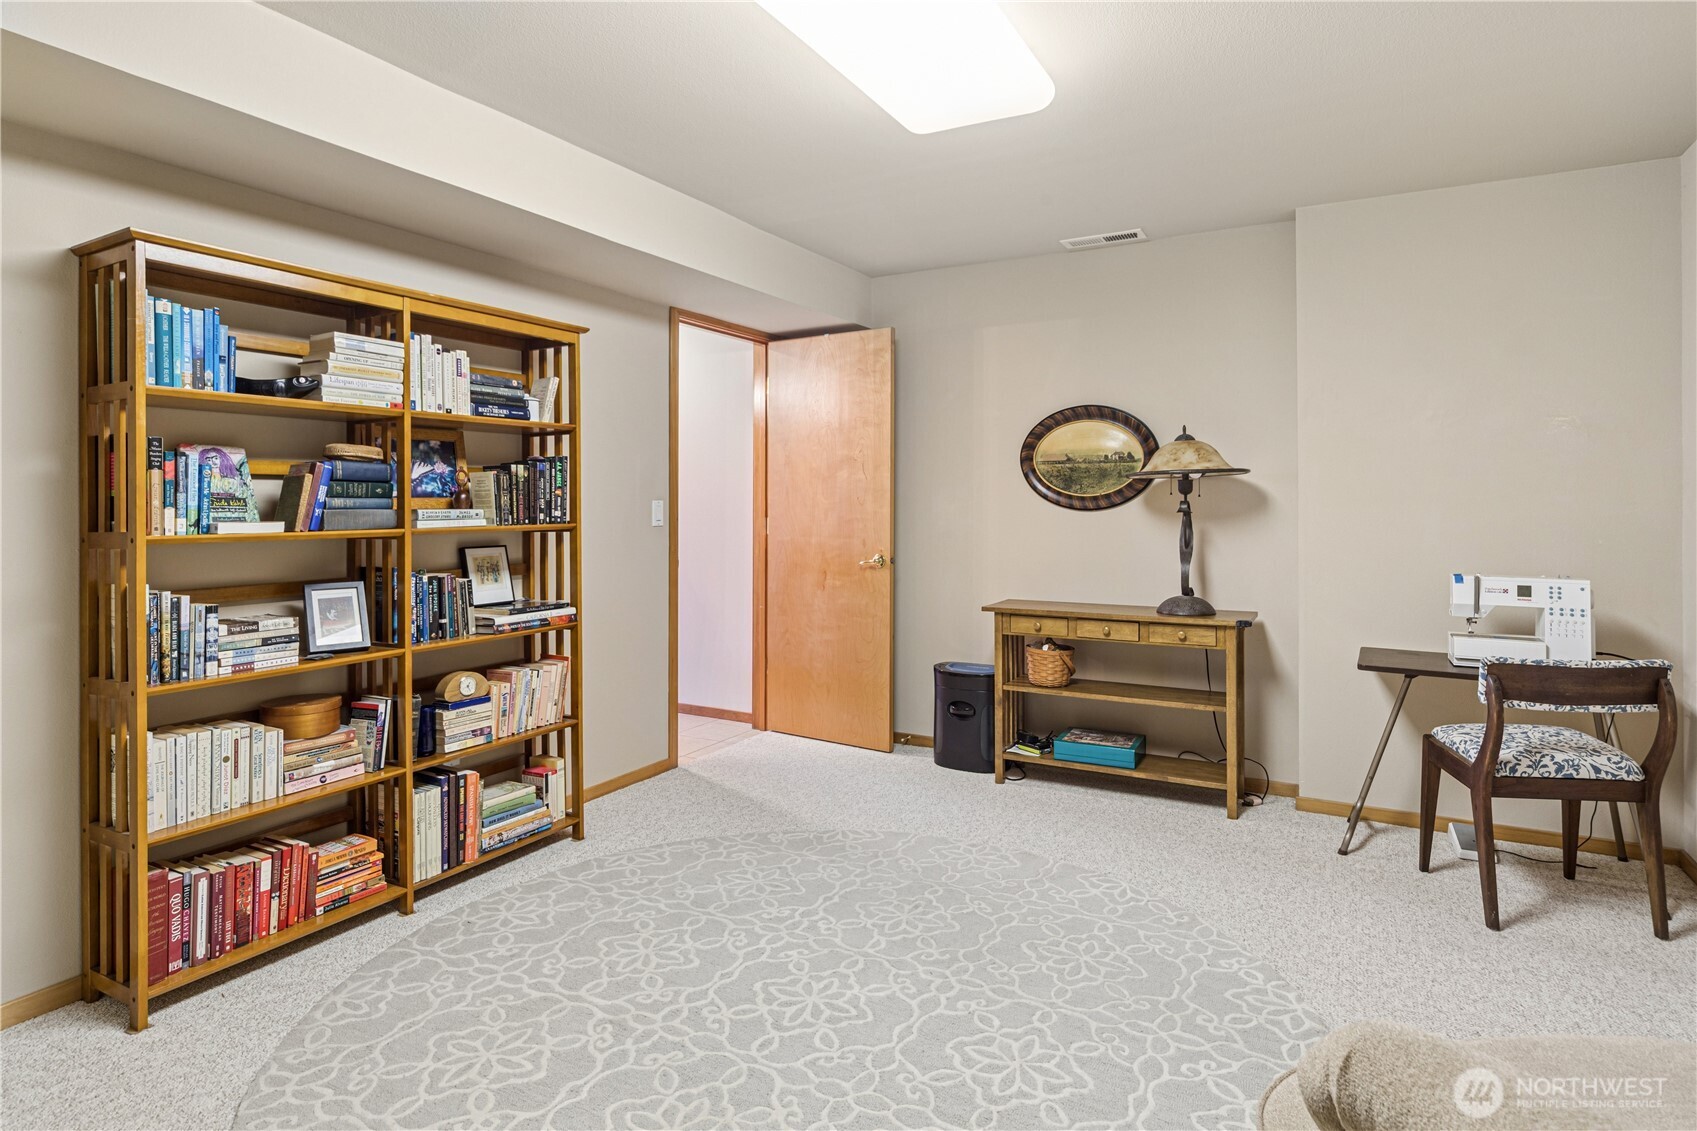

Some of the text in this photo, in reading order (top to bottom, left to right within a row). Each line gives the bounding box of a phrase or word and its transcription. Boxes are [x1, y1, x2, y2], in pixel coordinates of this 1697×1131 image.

[329, 377, 354, 385] Lifespan
[280, 867, 290, 910] Dictionary
[170, 893, 181, 942] QUO VADIS
